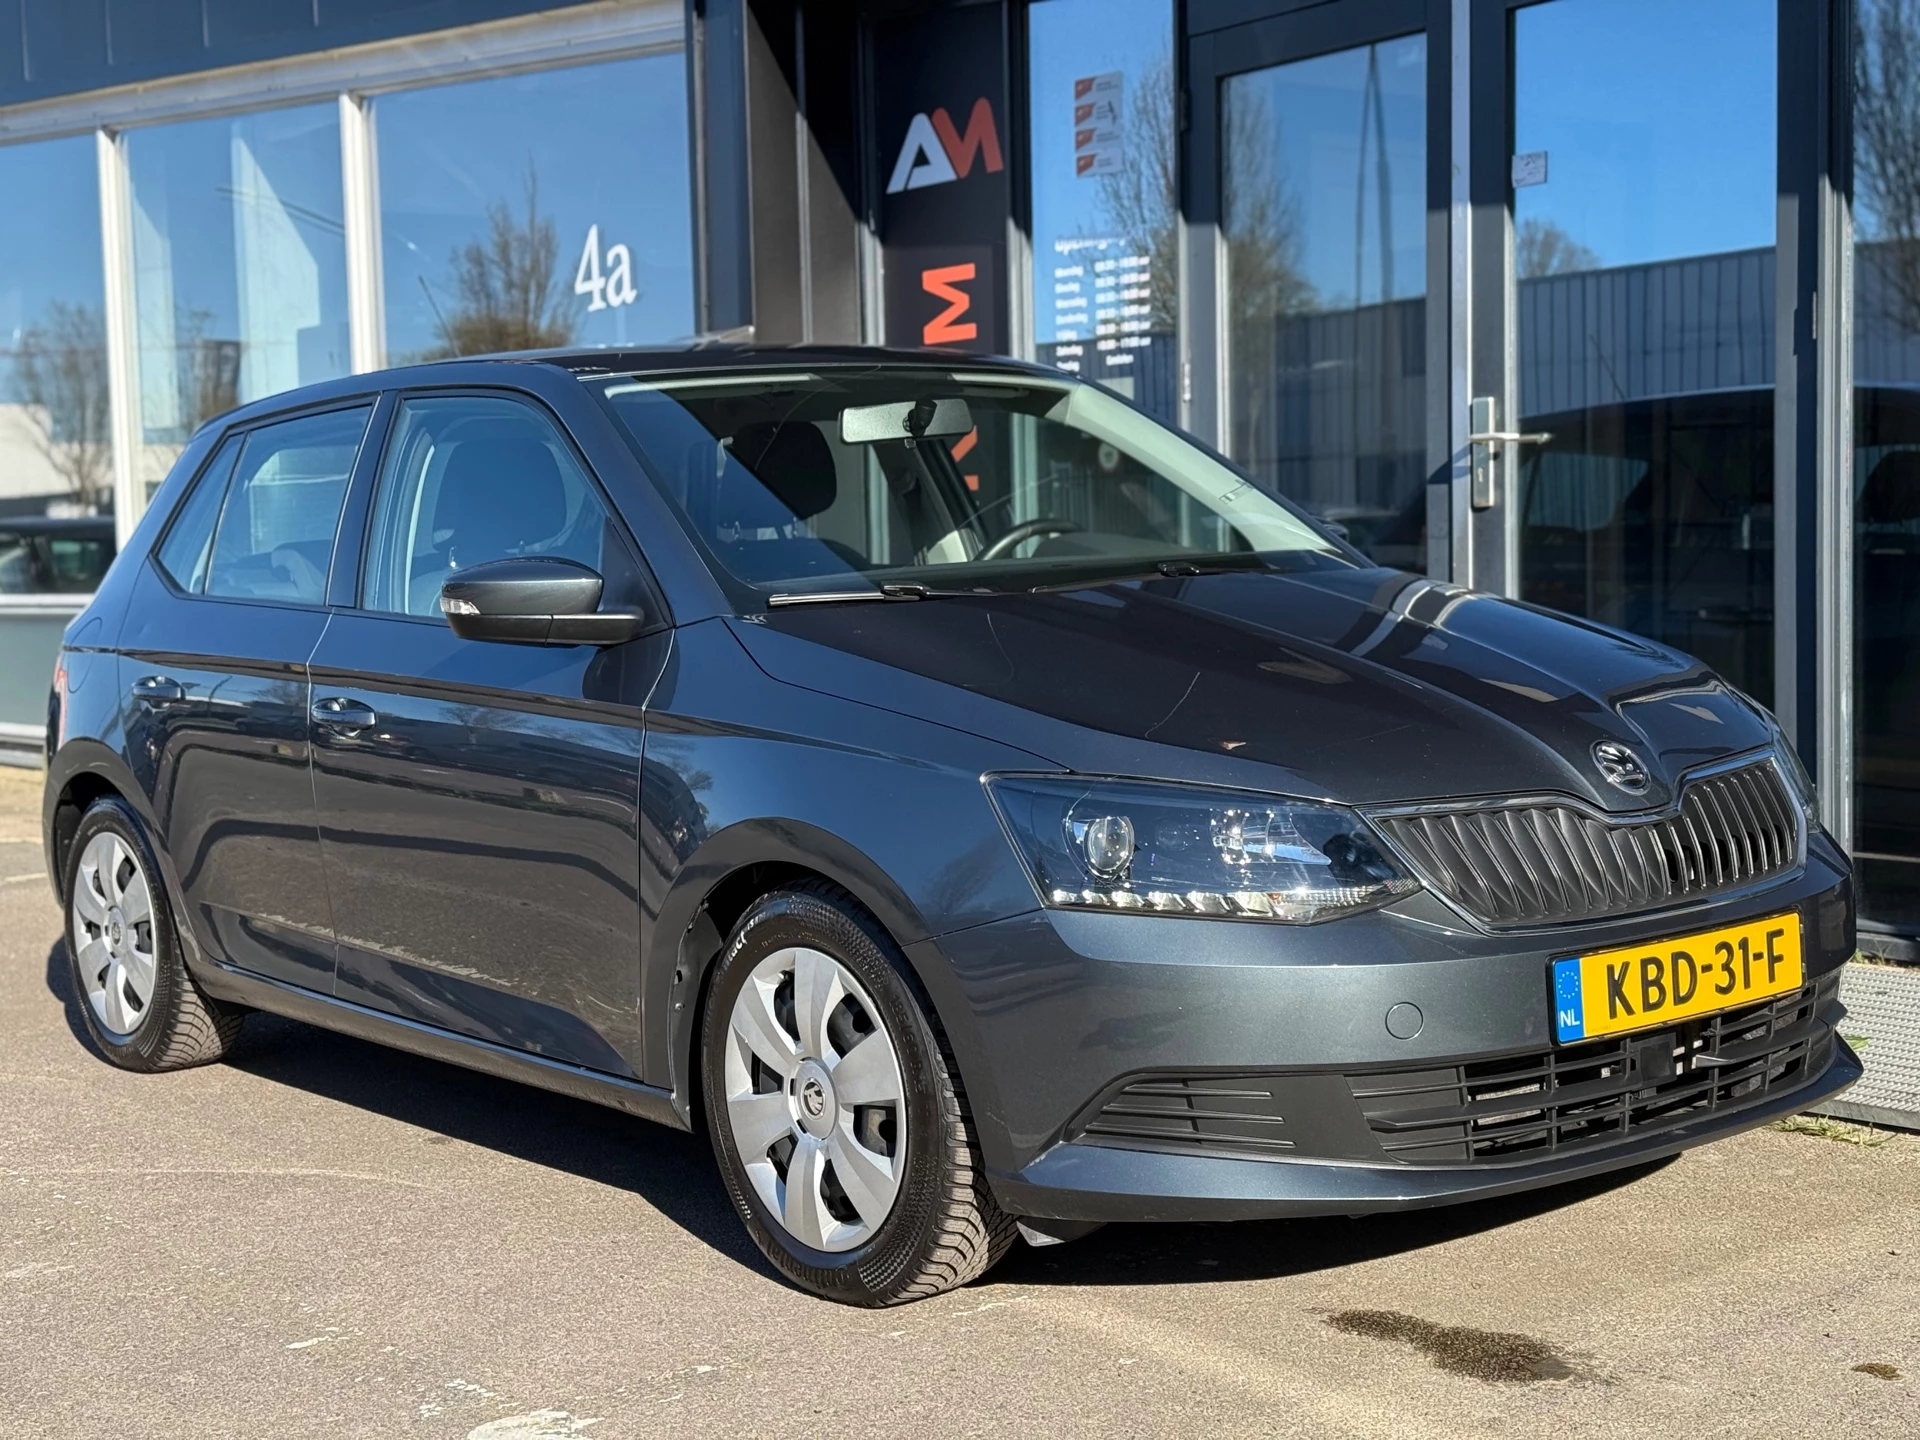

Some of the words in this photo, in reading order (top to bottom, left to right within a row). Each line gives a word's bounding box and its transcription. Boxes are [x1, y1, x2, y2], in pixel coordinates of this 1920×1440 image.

[887, 97, 1004, 194] AM
[574, 224, 638, 312] 4a
[1560, 1008, 1580, 1028] NL
[1606, 928, 1784, 1020] KBD-31-F
